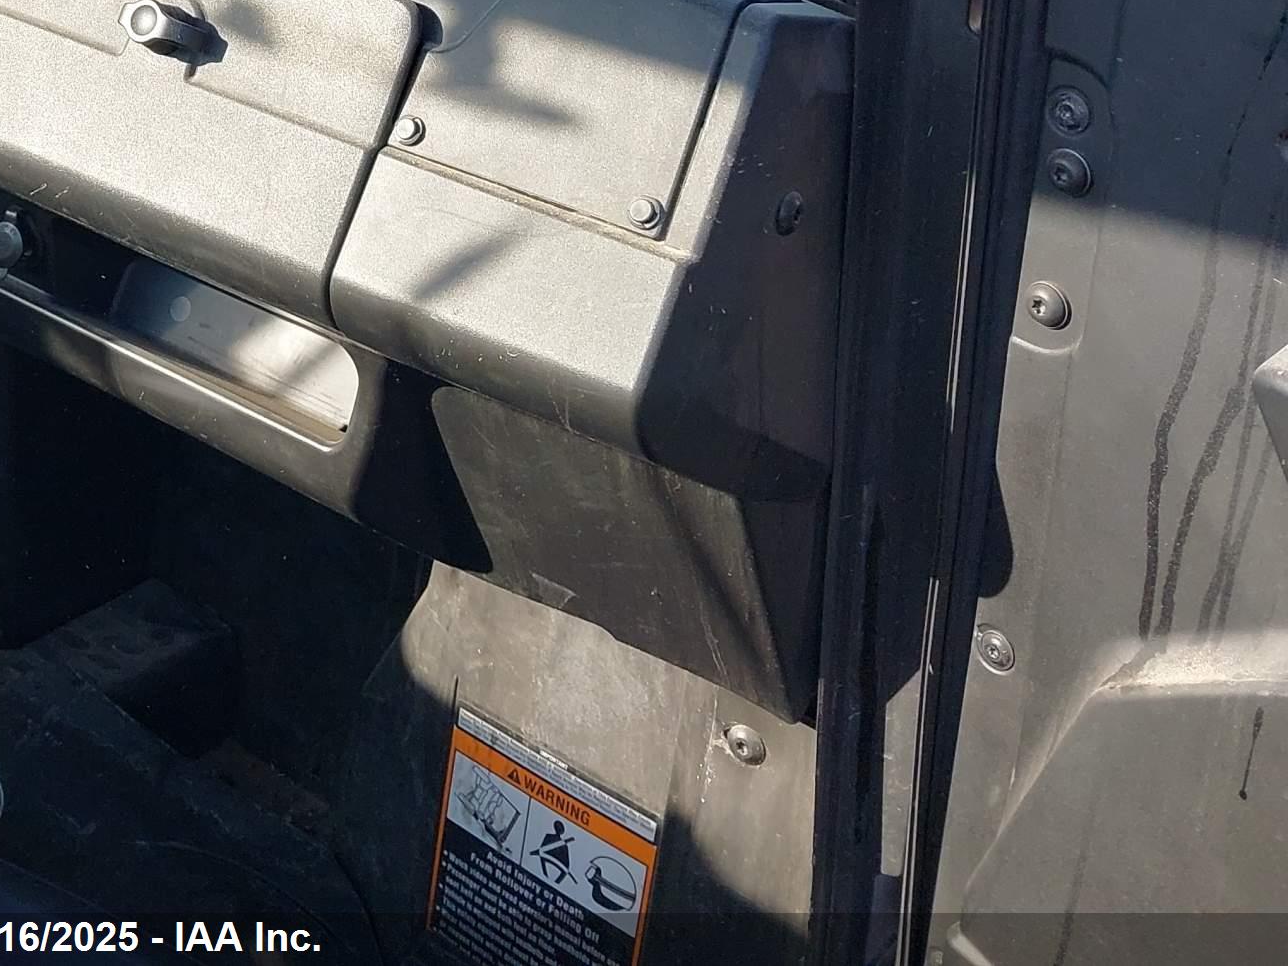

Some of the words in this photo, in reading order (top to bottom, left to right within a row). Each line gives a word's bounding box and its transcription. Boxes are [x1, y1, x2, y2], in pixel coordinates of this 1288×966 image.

[524, 776, 590, 826] WARNING
[470, 853, 492, 874] From
[495, 869, 533, 901] Rollover
[536, 897, 544, 908] or
[548, 904, 581, 933] Falling
[585, 927, 599, 943] Off
[487, 851, 511, 874] Avoid
[514, 869, 540, 894] Injury
[544, 890, 552, 900] or
[556, 897, 583, 920] Death
